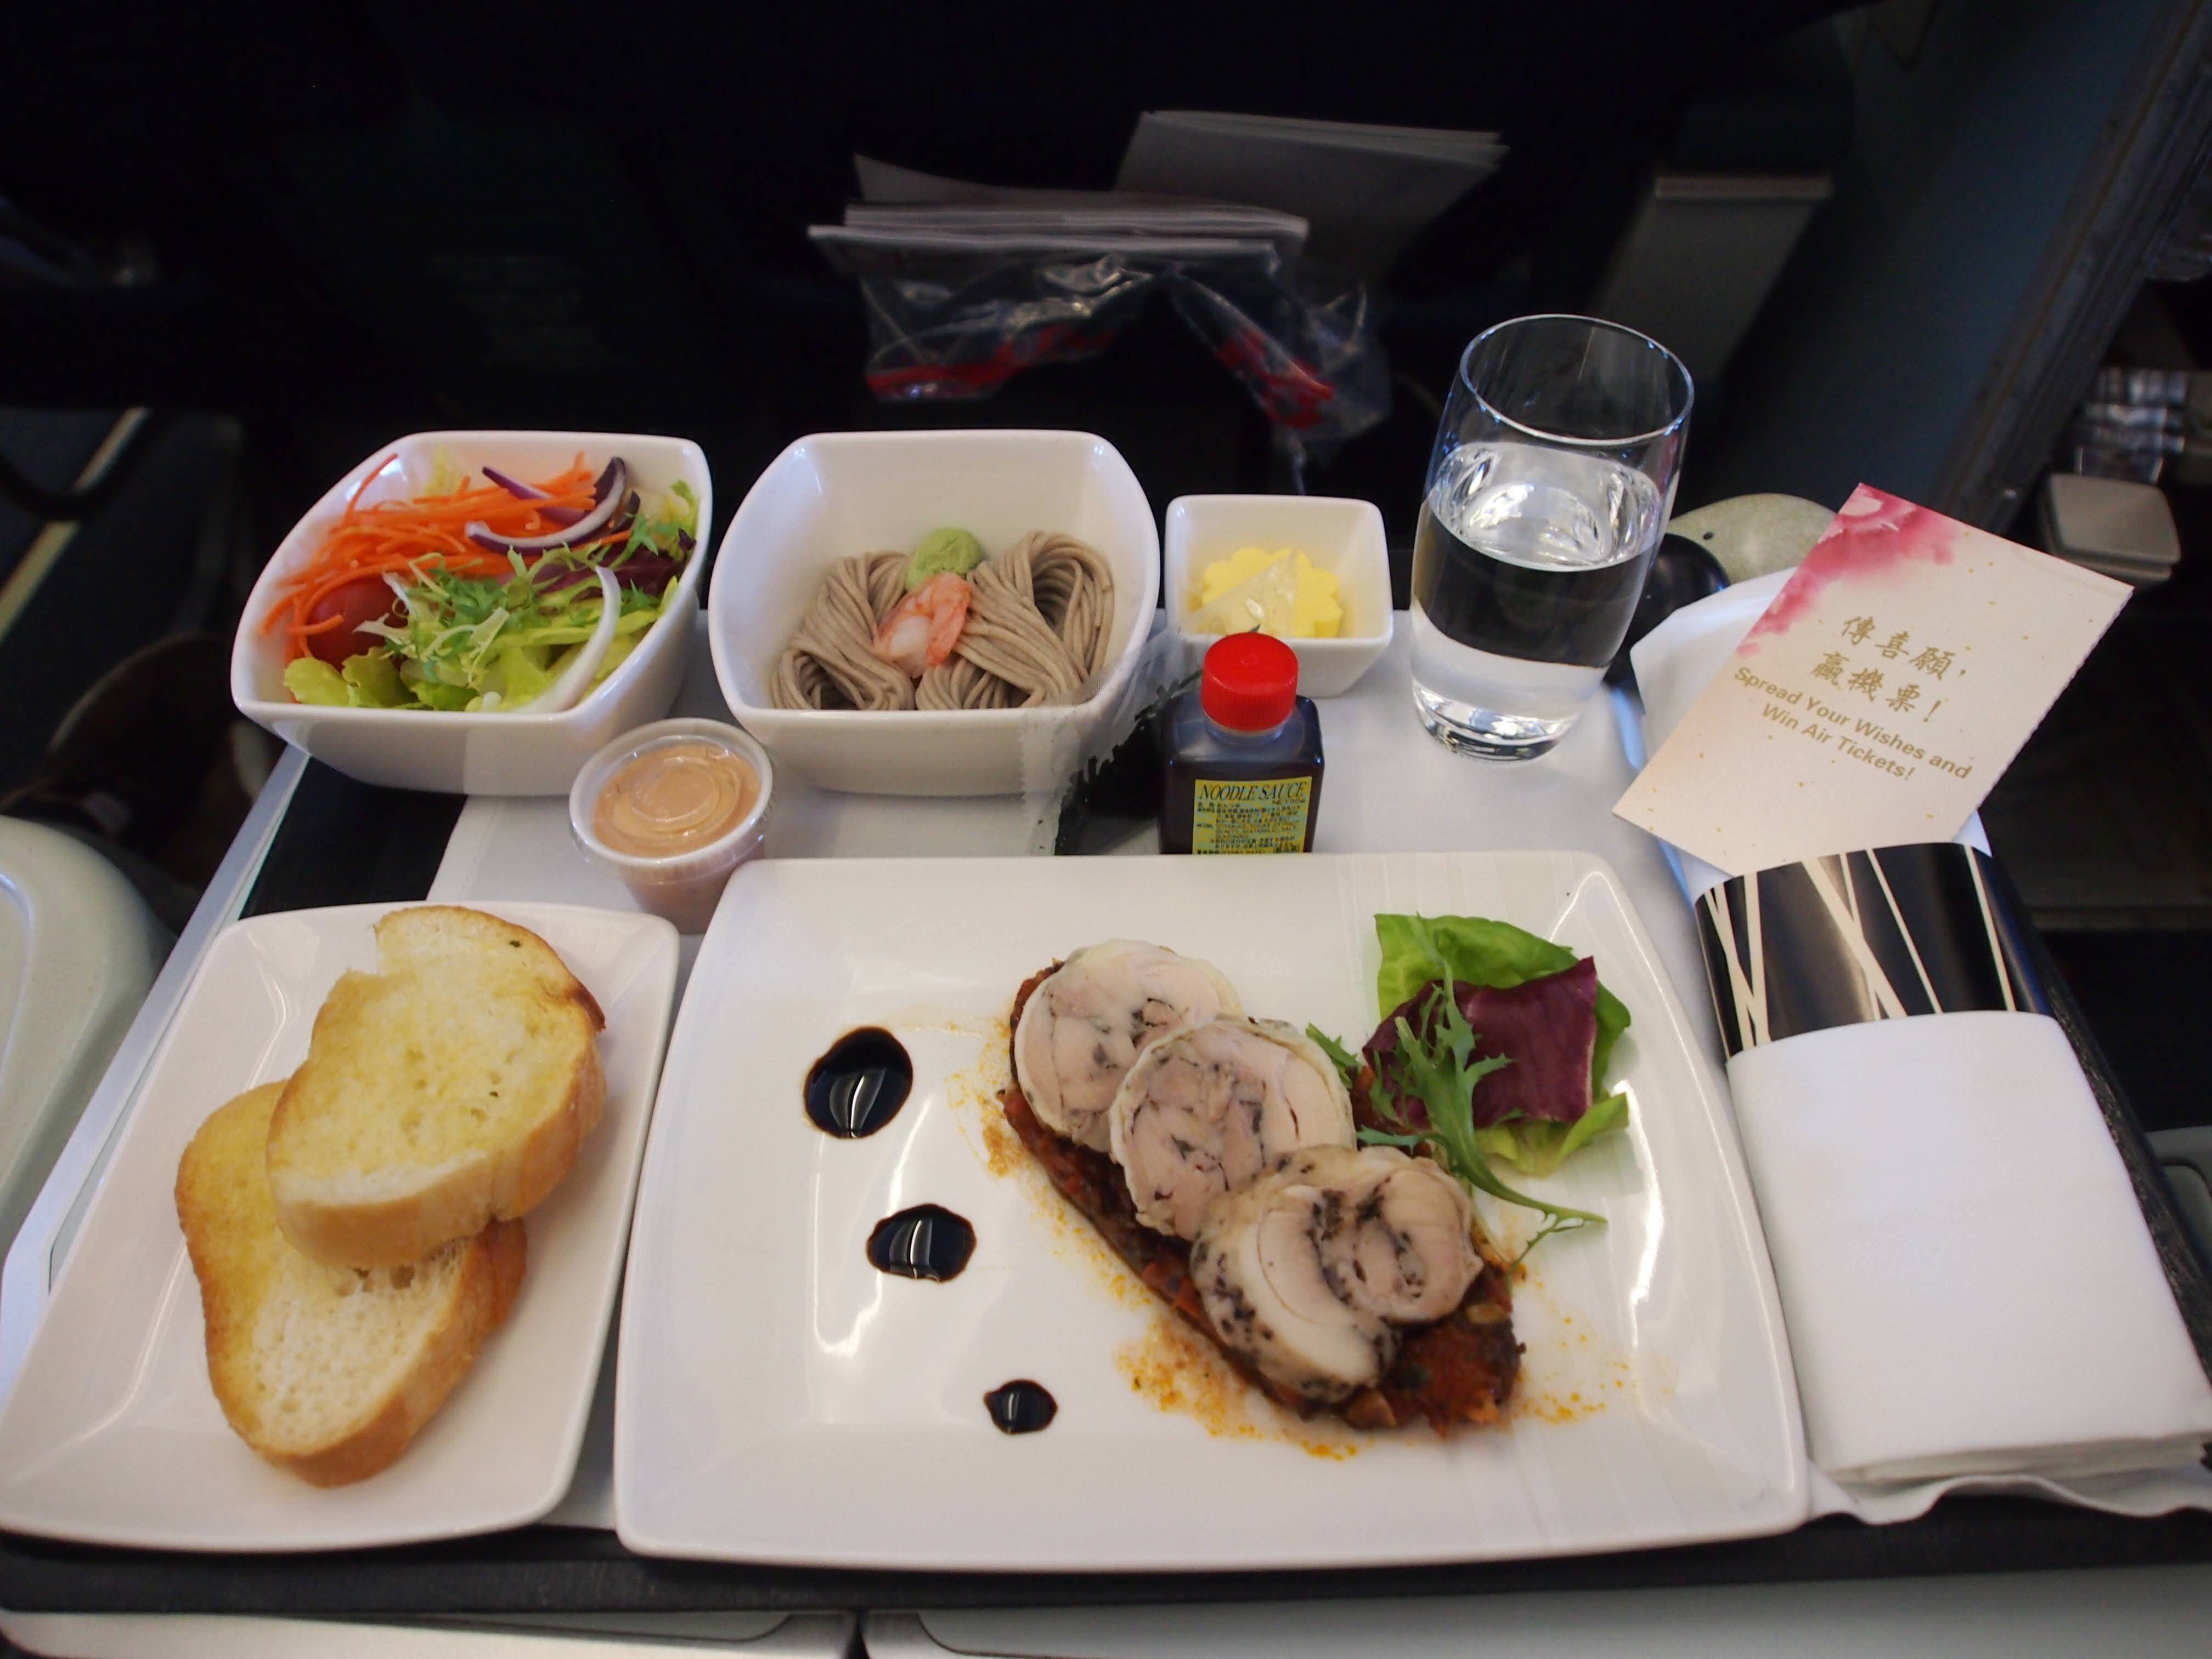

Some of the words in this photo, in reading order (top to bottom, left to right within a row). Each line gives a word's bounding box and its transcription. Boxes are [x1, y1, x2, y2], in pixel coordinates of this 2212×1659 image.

[1734, 667, 1803, 705] Spread
[1806, 696, 1852, 726] Your
[1854, 718, 1926, 759] Wishes
[1929, 755, 1973, 779] and
[1763, 703, 1799, 730] Win
[1802, 724, 1833, 743] Air
[1837, 736, 1916, 781] Tickets!
[1199, 785, 1259, 800] NOODLE
[1259, 781, 1308, 800] SAUCE
